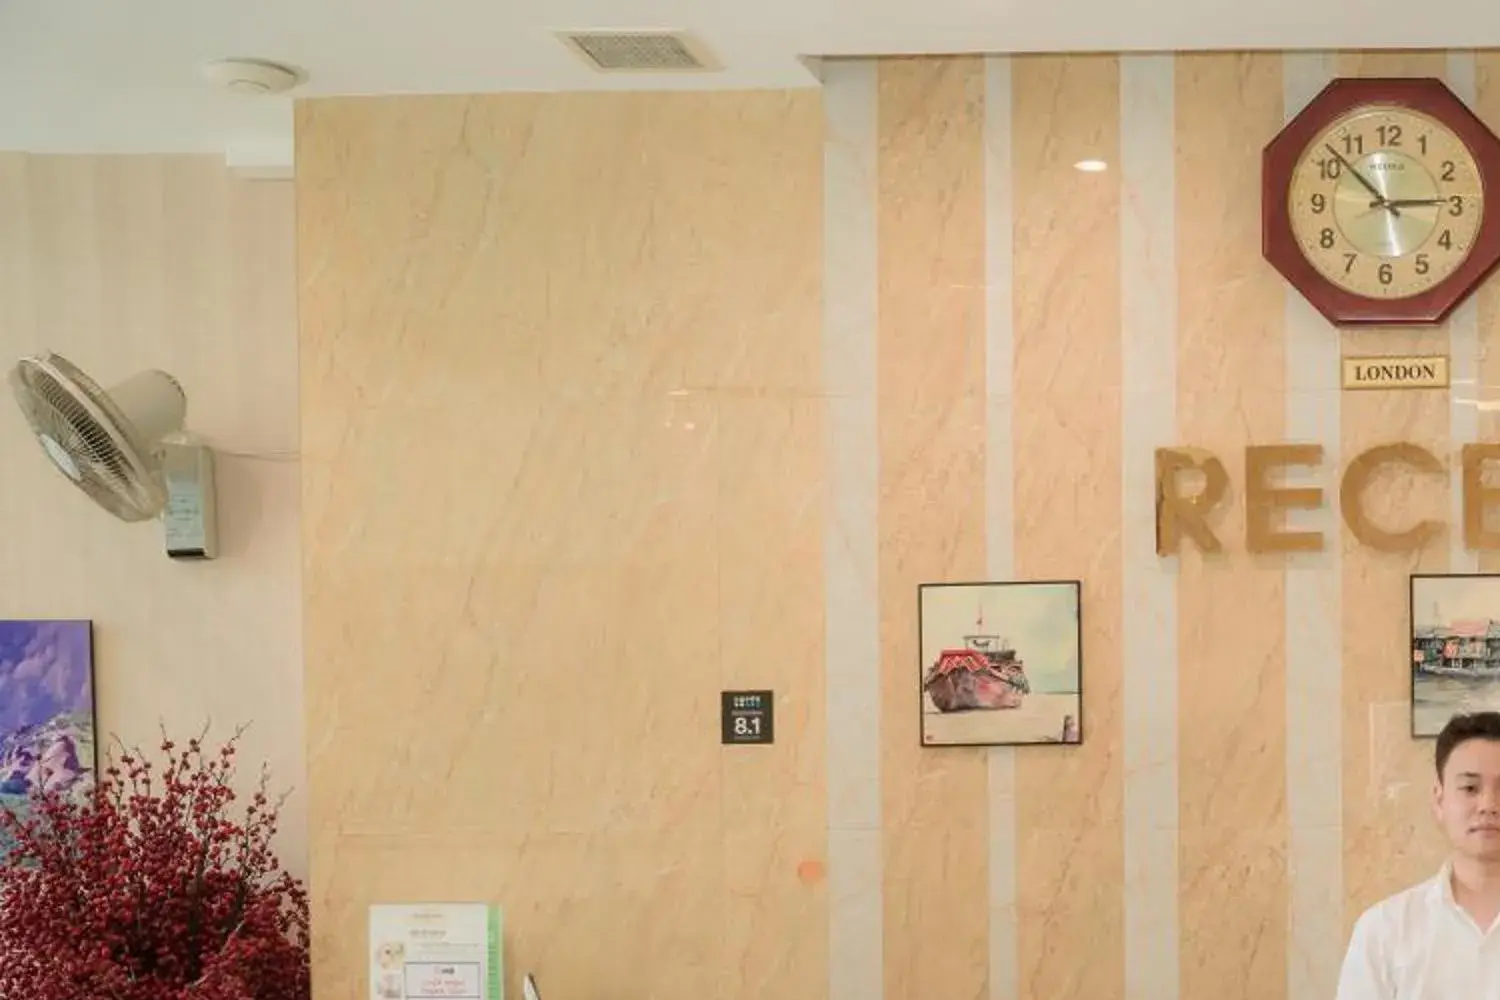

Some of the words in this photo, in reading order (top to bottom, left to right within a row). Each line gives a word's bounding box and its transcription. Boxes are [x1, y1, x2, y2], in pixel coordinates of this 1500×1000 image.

[1342, 135, 1363, 154] 11
[1376, 125, 1402, 146] 12
[1418, 135, 1427, 155] 1
[1318, 158, 1341, 179] 10
[1441, 161, 1456, 181] 2
[1311, 194, 1325, 214] 9
[1449, 195, 1462, 216] 3
[1320, 228, 1334, 249] 8
[1438, 229, 1451, 250] 4
[1343, 253, 1357, 273] 7
[1415, 254, 1429, 274] 5
[1379, 263, 1393, 284] 6
[1355, 365, 1436, 381] LONDON
[735, 717, 761, 735] 8.1
